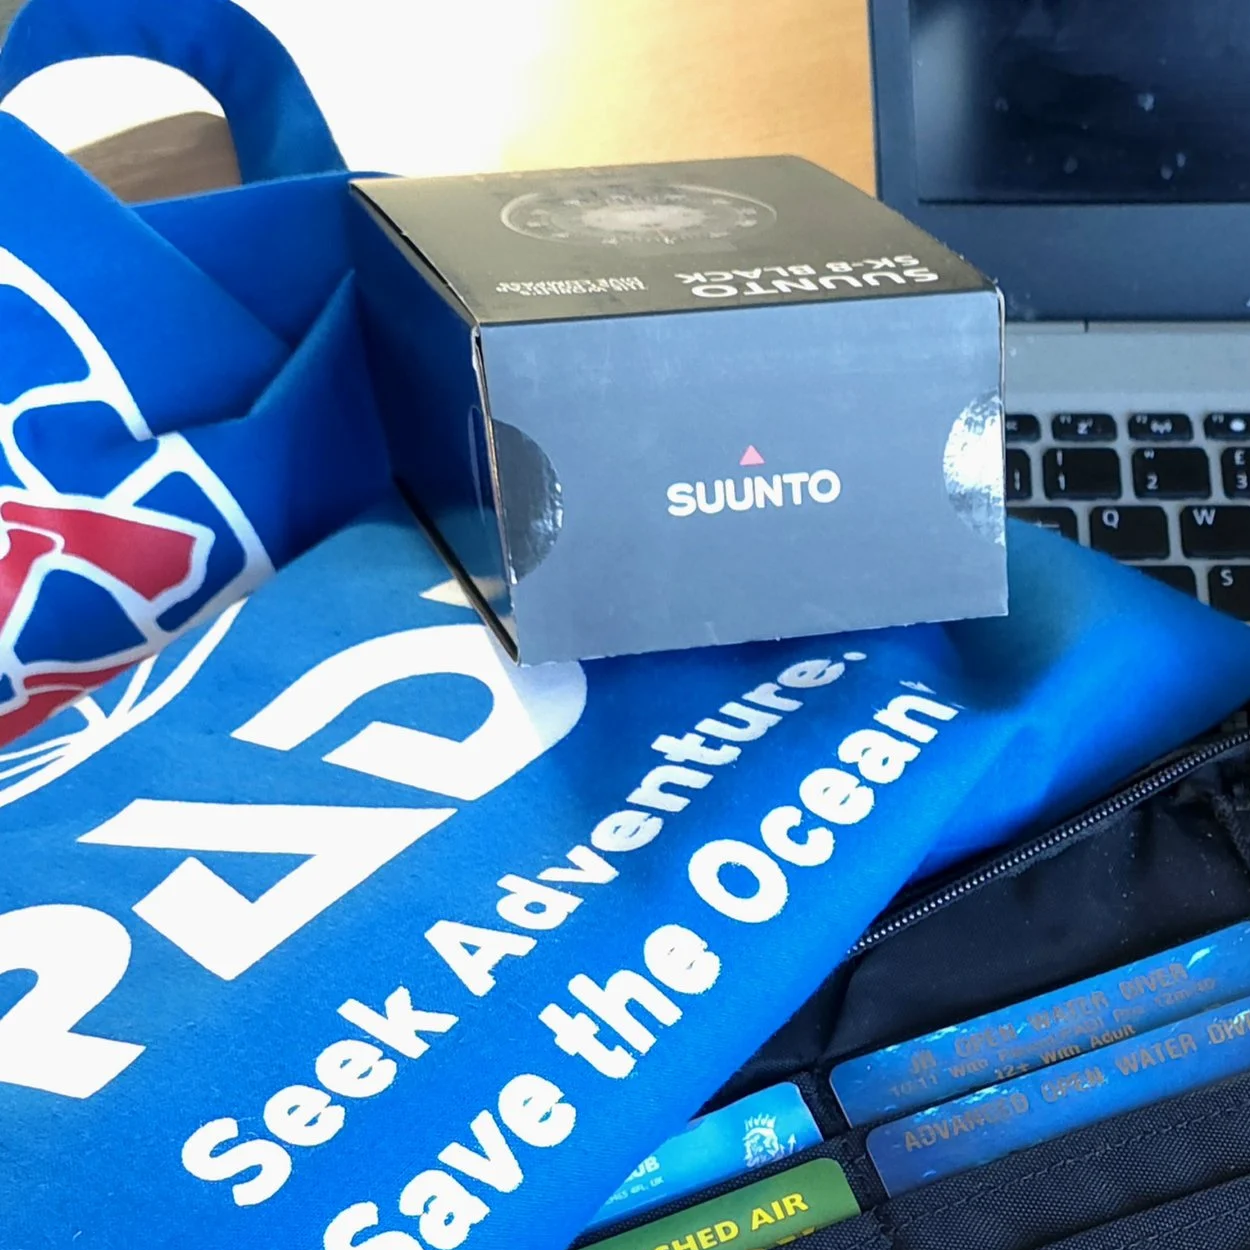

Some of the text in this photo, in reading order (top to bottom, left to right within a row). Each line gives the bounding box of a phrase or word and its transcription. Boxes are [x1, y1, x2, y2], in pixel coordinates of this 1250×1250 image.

[673, 264, 817, 285] BLACK
[691, 267, 940, 299] SUUNTO
[665, 469, 842, 518] SUUNTO
[1147, 473, 1158, 490] 2
[1236, 472, 1248, 489] 3
[1102, 509, 1119, 529] Q
[1193, 508, 1216, 526] W
[1220, 569, 1234, 587] S
[181, 651, 868, 1207] Seek Adventure.
[538, 923, 722, 1079] the
[954, 1024, 1017, 1060] OPEN
[1026, 991, 1109, 1032] WATER
[1119, 963, 1190, 1002] DIVER
[1041, 1042, 1082, 1066] With
[1090, 1023, 1136, 1048] Adult
[1040, 1066, 1104, 1105] OPEN
[1116, 1033, 1197, 1076] WATER
[749, 1192, 810, 1232] AIR
